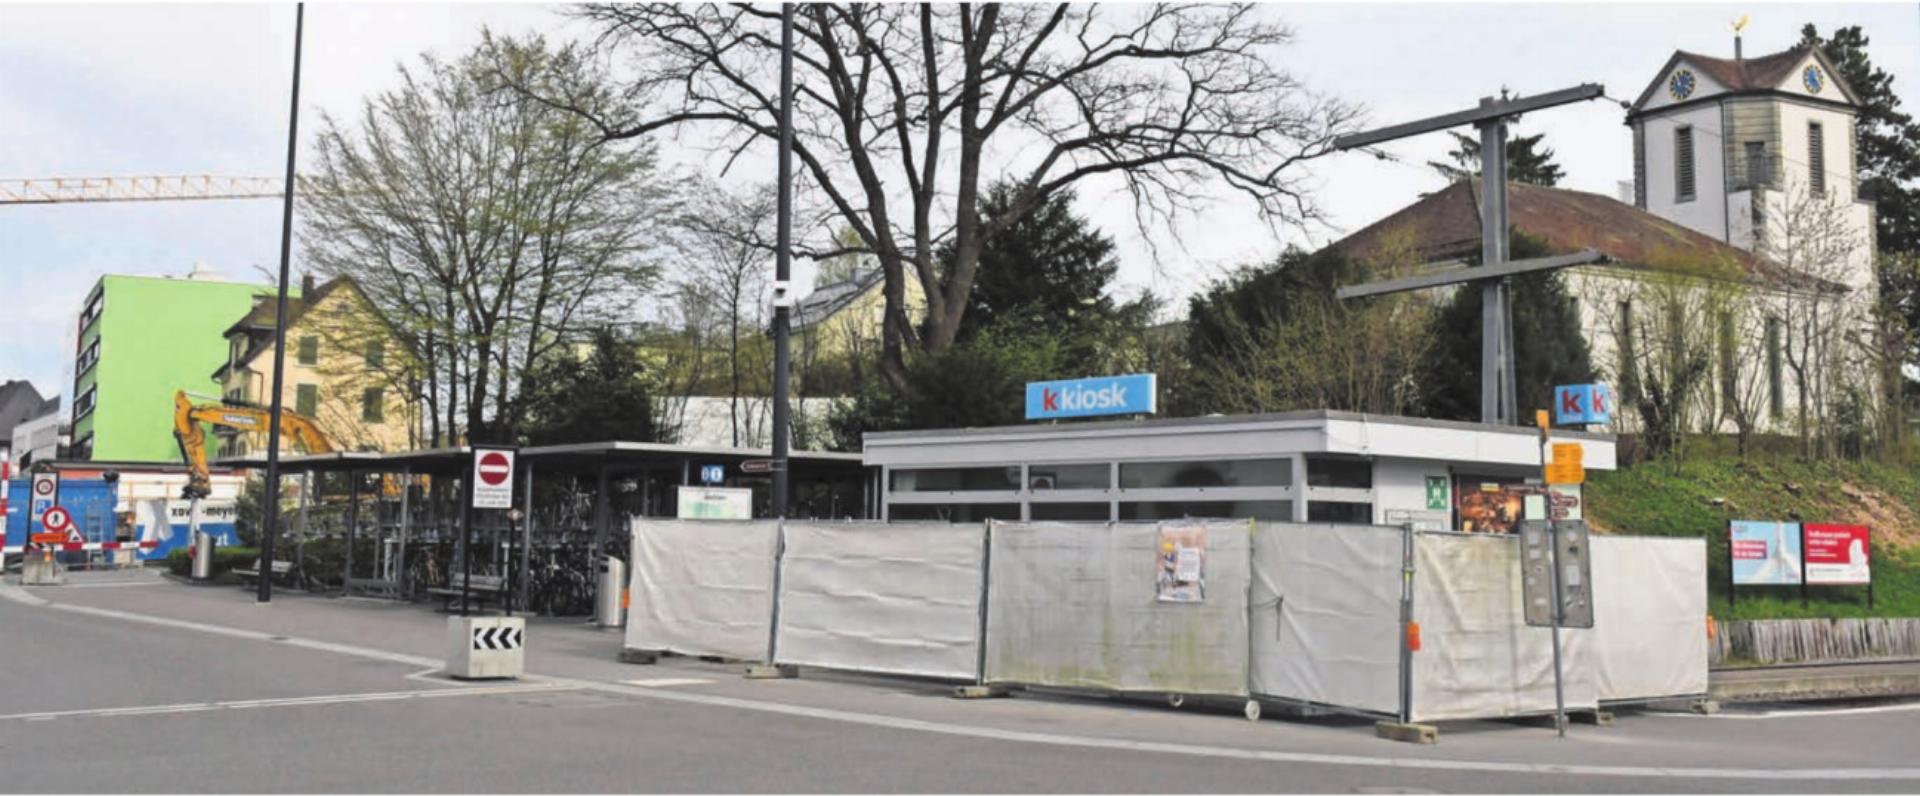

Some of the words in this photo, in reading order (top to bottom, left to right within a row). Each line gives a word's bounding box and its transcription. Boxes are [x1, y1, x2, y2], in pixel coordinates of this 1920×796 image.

[1043, 387, 1058, 411] k
[1061, 383, 1127, 410] kiosk
[1562, 390, 1582, 413] k
[1592, 388, 1606, 413] k
